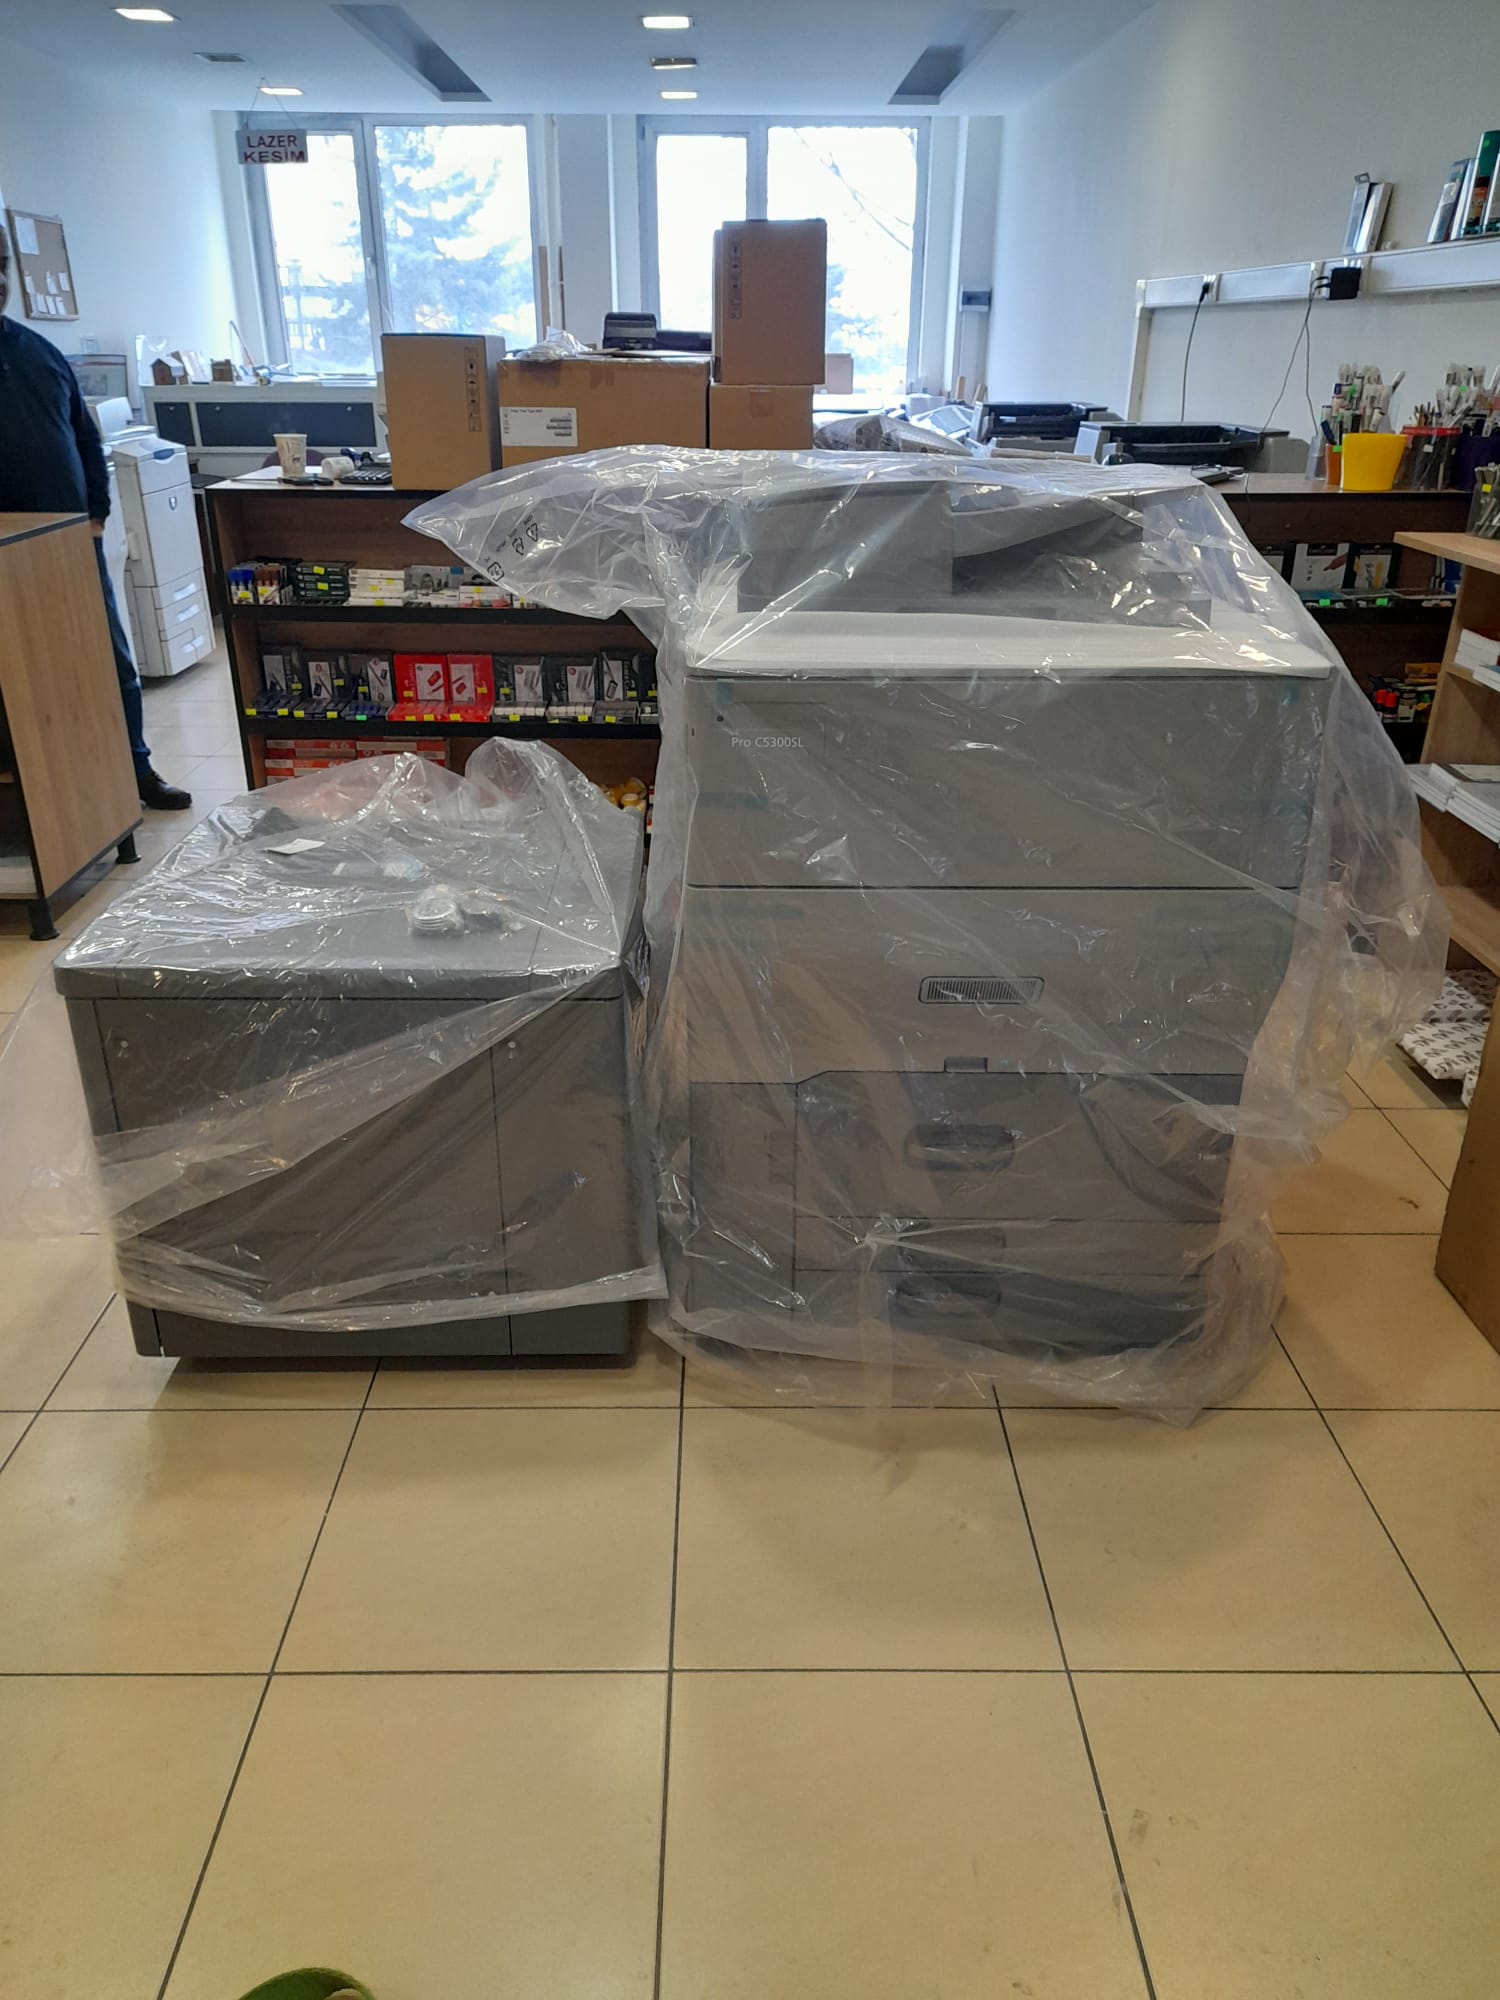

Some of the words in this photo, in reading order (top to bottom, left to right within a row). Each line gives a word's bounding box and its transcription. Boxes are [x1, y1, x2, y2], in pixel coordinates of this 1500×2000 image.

[246, 135, 297, 148] LAZER
[731, 736, 751, 748] Pro
[755, 736, 804, 748] C5300SL
